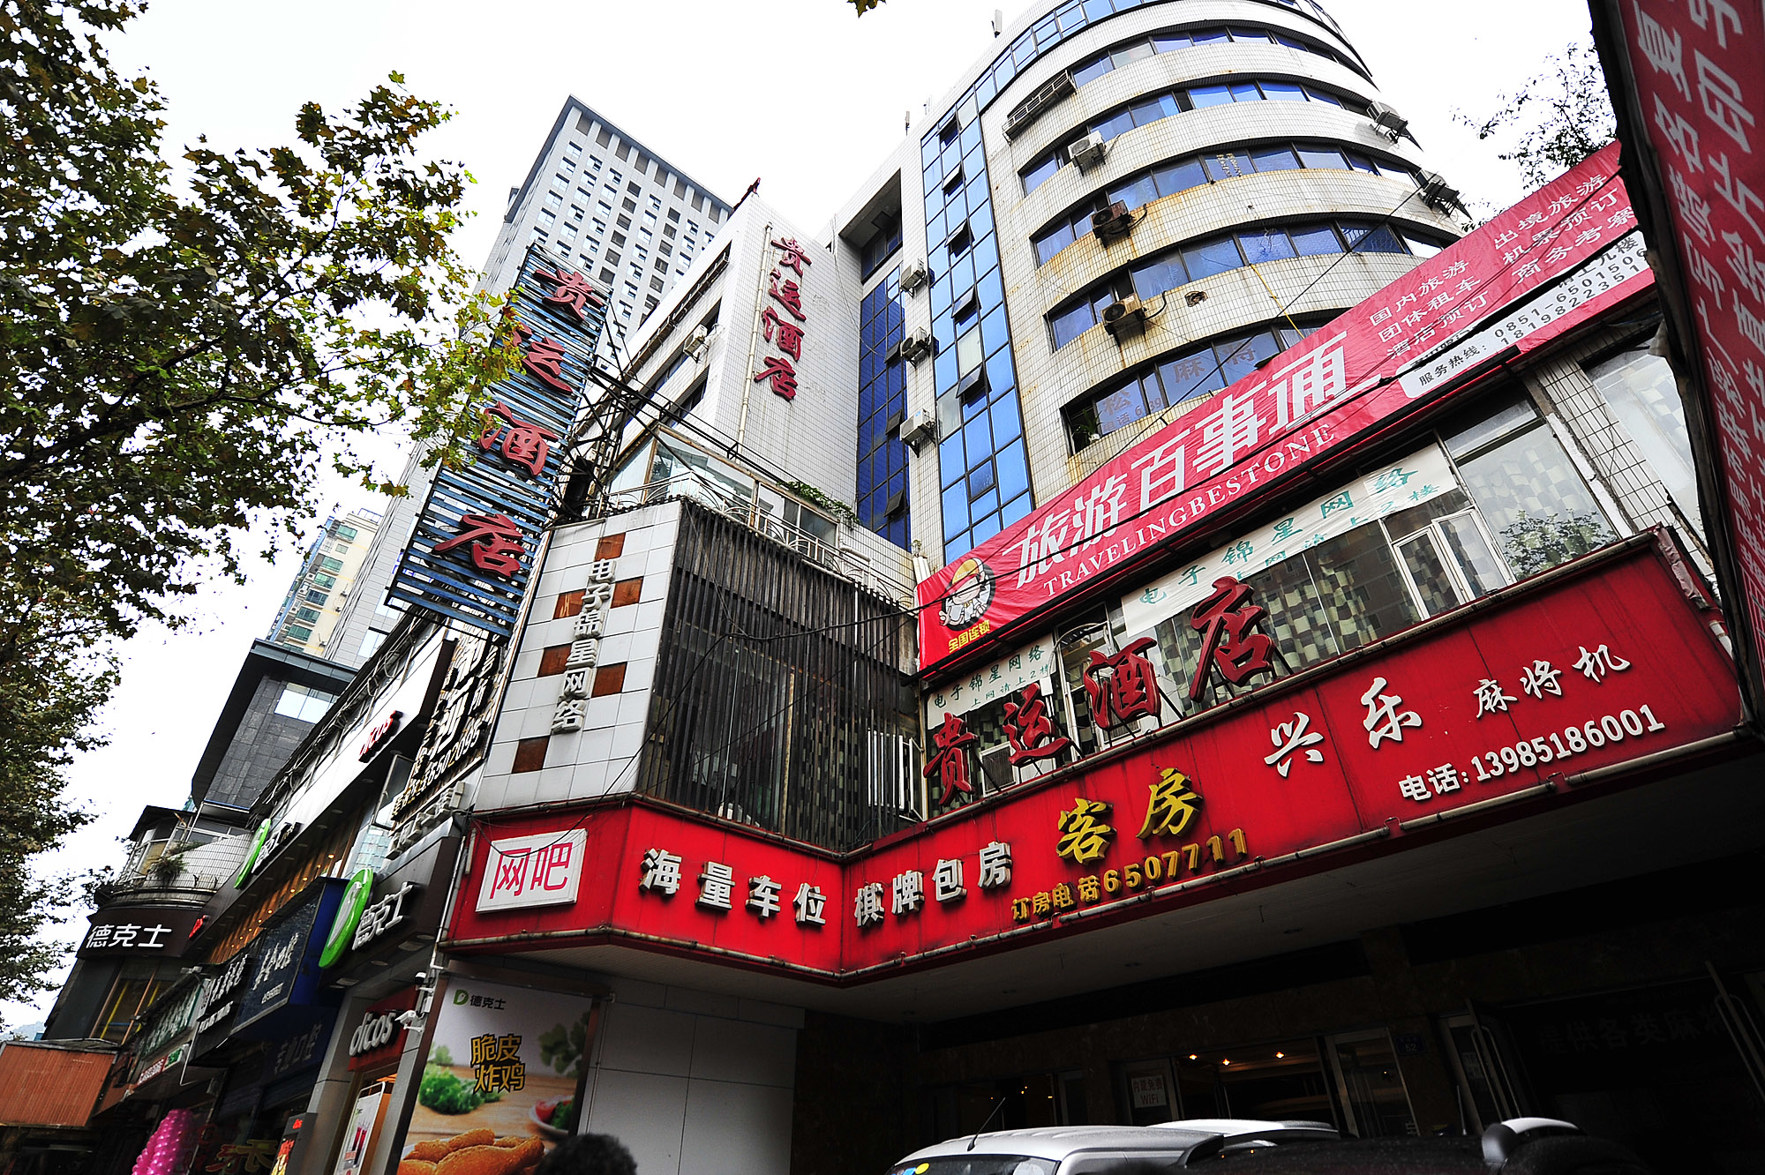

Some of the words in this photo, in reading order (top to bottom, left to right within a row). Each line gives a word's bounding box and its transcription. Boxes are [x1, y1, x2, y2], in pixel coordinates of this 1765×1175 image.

[1494, 173, 1608, 250] 出境旅游
[1502, 188, 1618, 265] 机票预订
[1512, 205, 1635, 283] 商务考察
[753, 237, 812, 402] 贵运酒店
[1370, 259, 1469, 327] 国内旅游
[1378, 276, 1481, 343] 团体租车
[1387, 290, 1489, 360] 酒店预订
[1494, 247, 1646, 339] 0851-6501506
[1001, 330, 1382, 590] 旅游百事通
[1043, 422, 1336, 597] TRAVELINGBESTONE
[1139, 467, 1418, 605] 电子锦星网络
[550, 558, 617, 735] 电子锦星网络
[948, 619, 991, 654] 全国连锁
[923, 575, 1281, 804] 贵运酒店
[934, 644, 1045, 709] 电子锦星网络
[1263, 677, 1423, 778] 兴乐
[1472, 644, 1631, 720] 麻将机
[1056, 767, 1204, 866] 客房
[489, 842, 574, 900] 网吧
[638, 847, 827, 928] 海量车位
[853, 841, 1014, 928] 棋牌包房
[86, 923, 172, 949] 德克士
[352, 881, 414, 951] 德克士
[349, 1011, 398, 1056] dicos
[470, 994, 507, 1011] 德克士
[470, 1033, 523, 1066] 脆皮
[473, 1063, 526, 1095] 炸鸡
